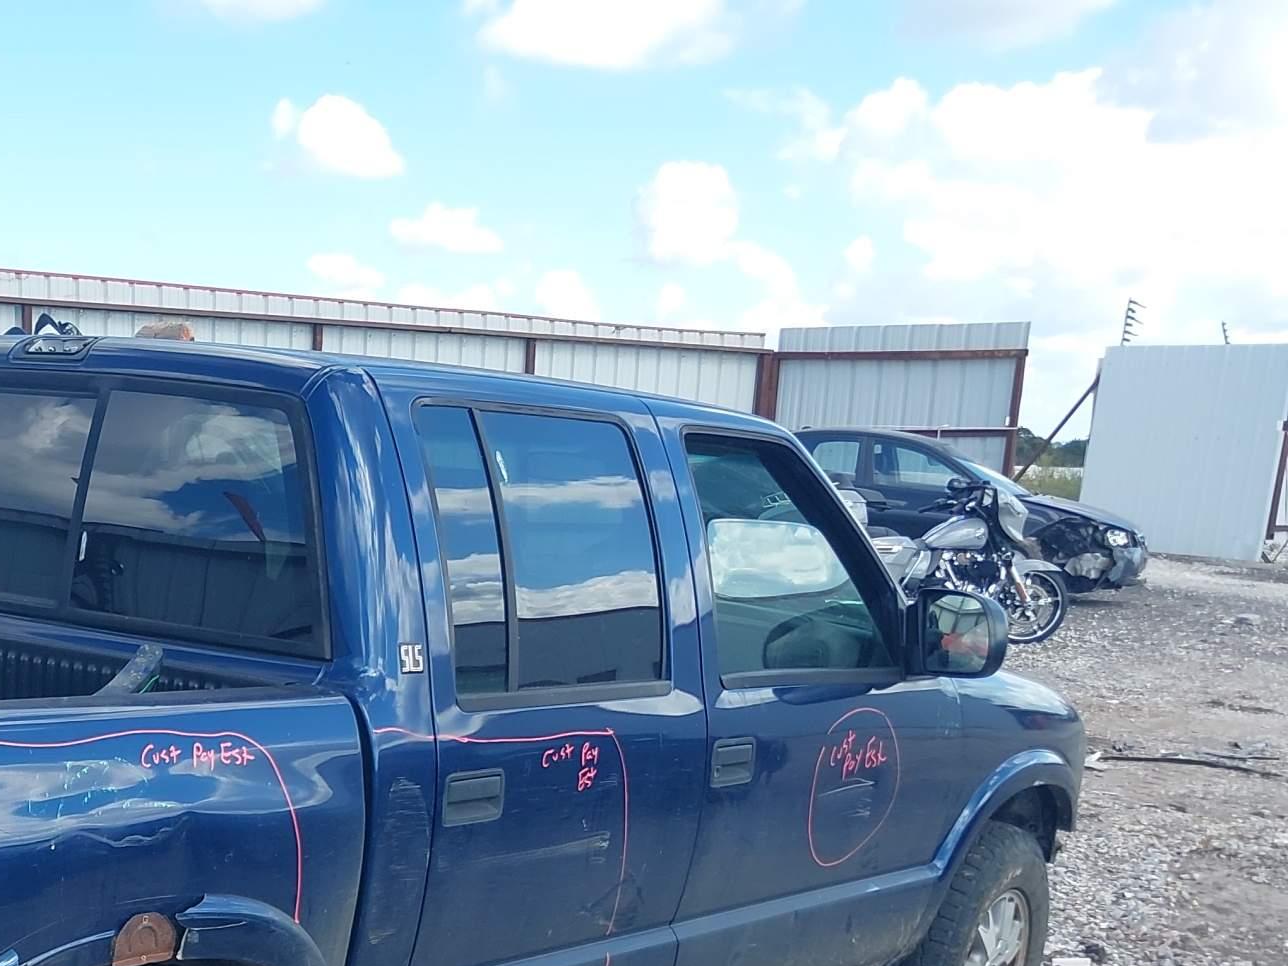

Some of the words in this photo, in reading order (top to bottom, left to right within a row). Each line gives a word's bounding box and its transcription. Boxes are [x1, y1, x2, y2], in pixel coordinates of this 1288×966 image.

[400, 644, 424, 673] SLS
[140, 743, 182, 769] Cust
[192, 742, 216, 771] Pay
